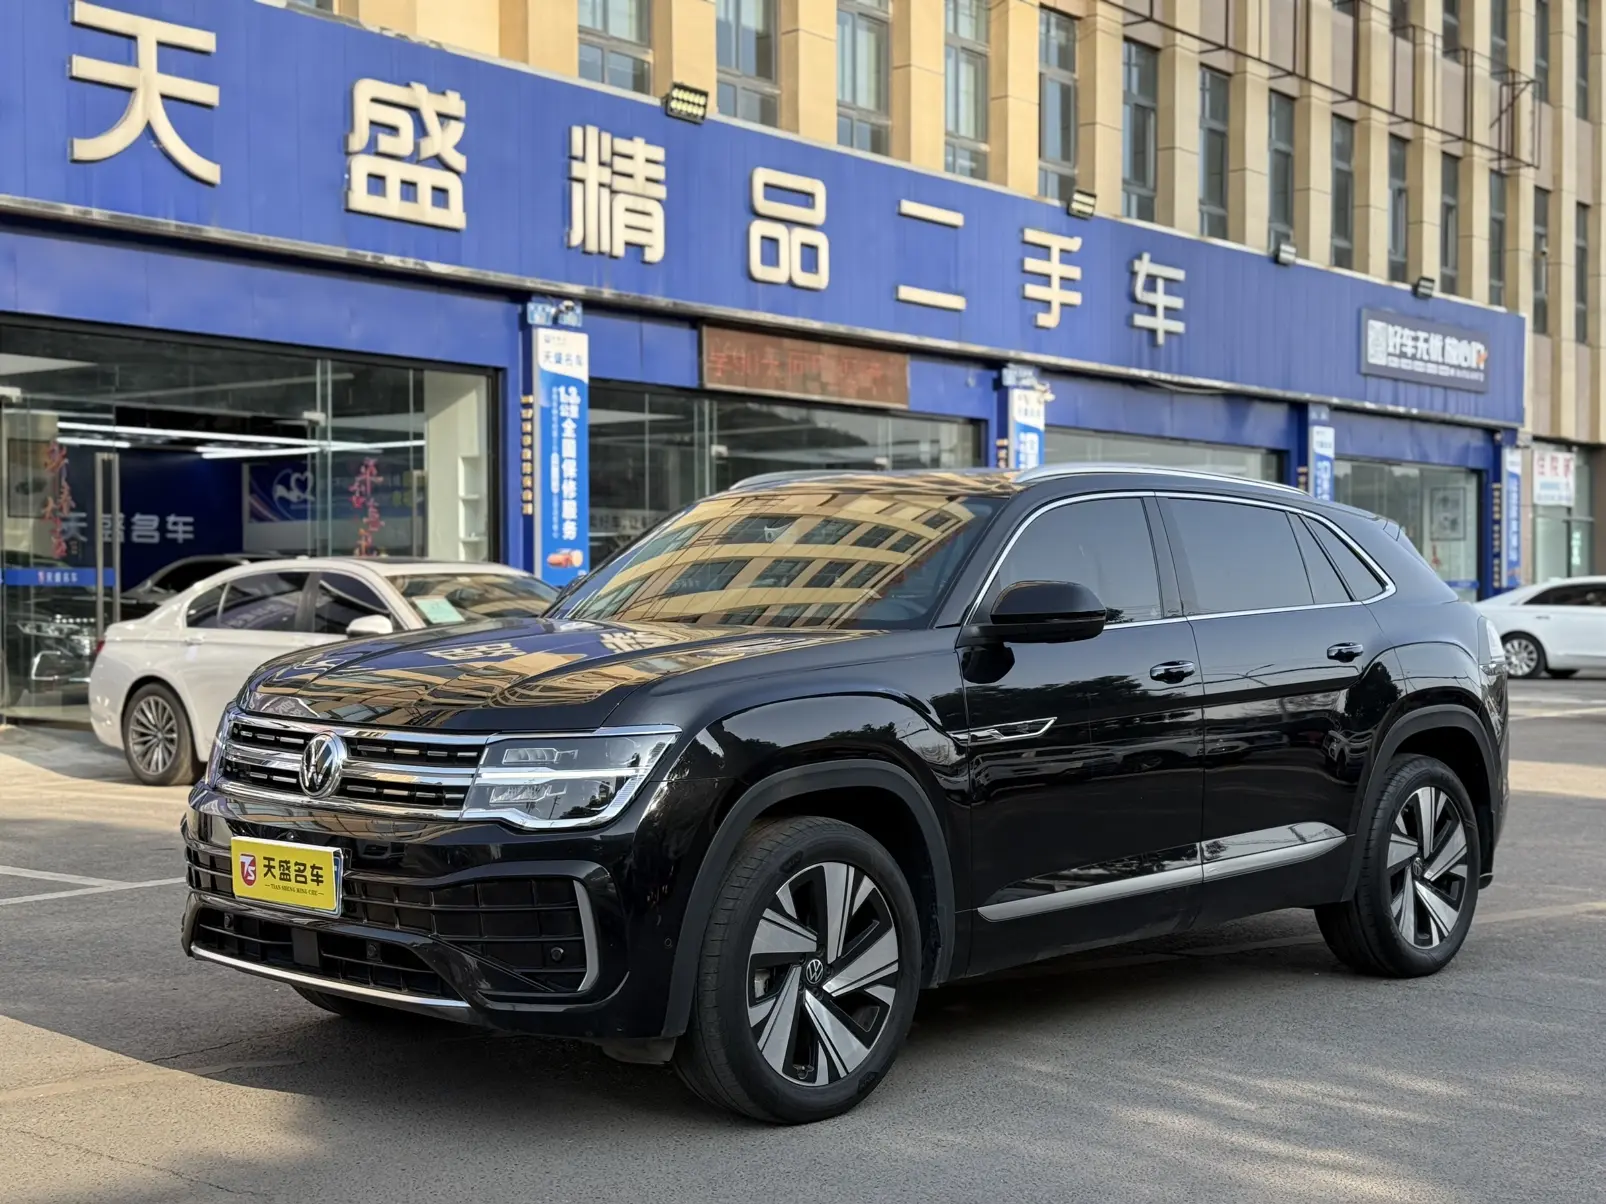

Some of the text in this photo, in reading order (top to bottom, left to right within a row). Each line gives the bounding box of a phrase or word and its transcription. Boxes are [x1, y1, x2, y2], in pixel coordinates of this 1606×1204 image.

[69, 0, 1186, 347] 天盛精品二手车
[561, 418, 578, 541] 全国保修服务
[263, 856, 324, 887] 天盛名车
